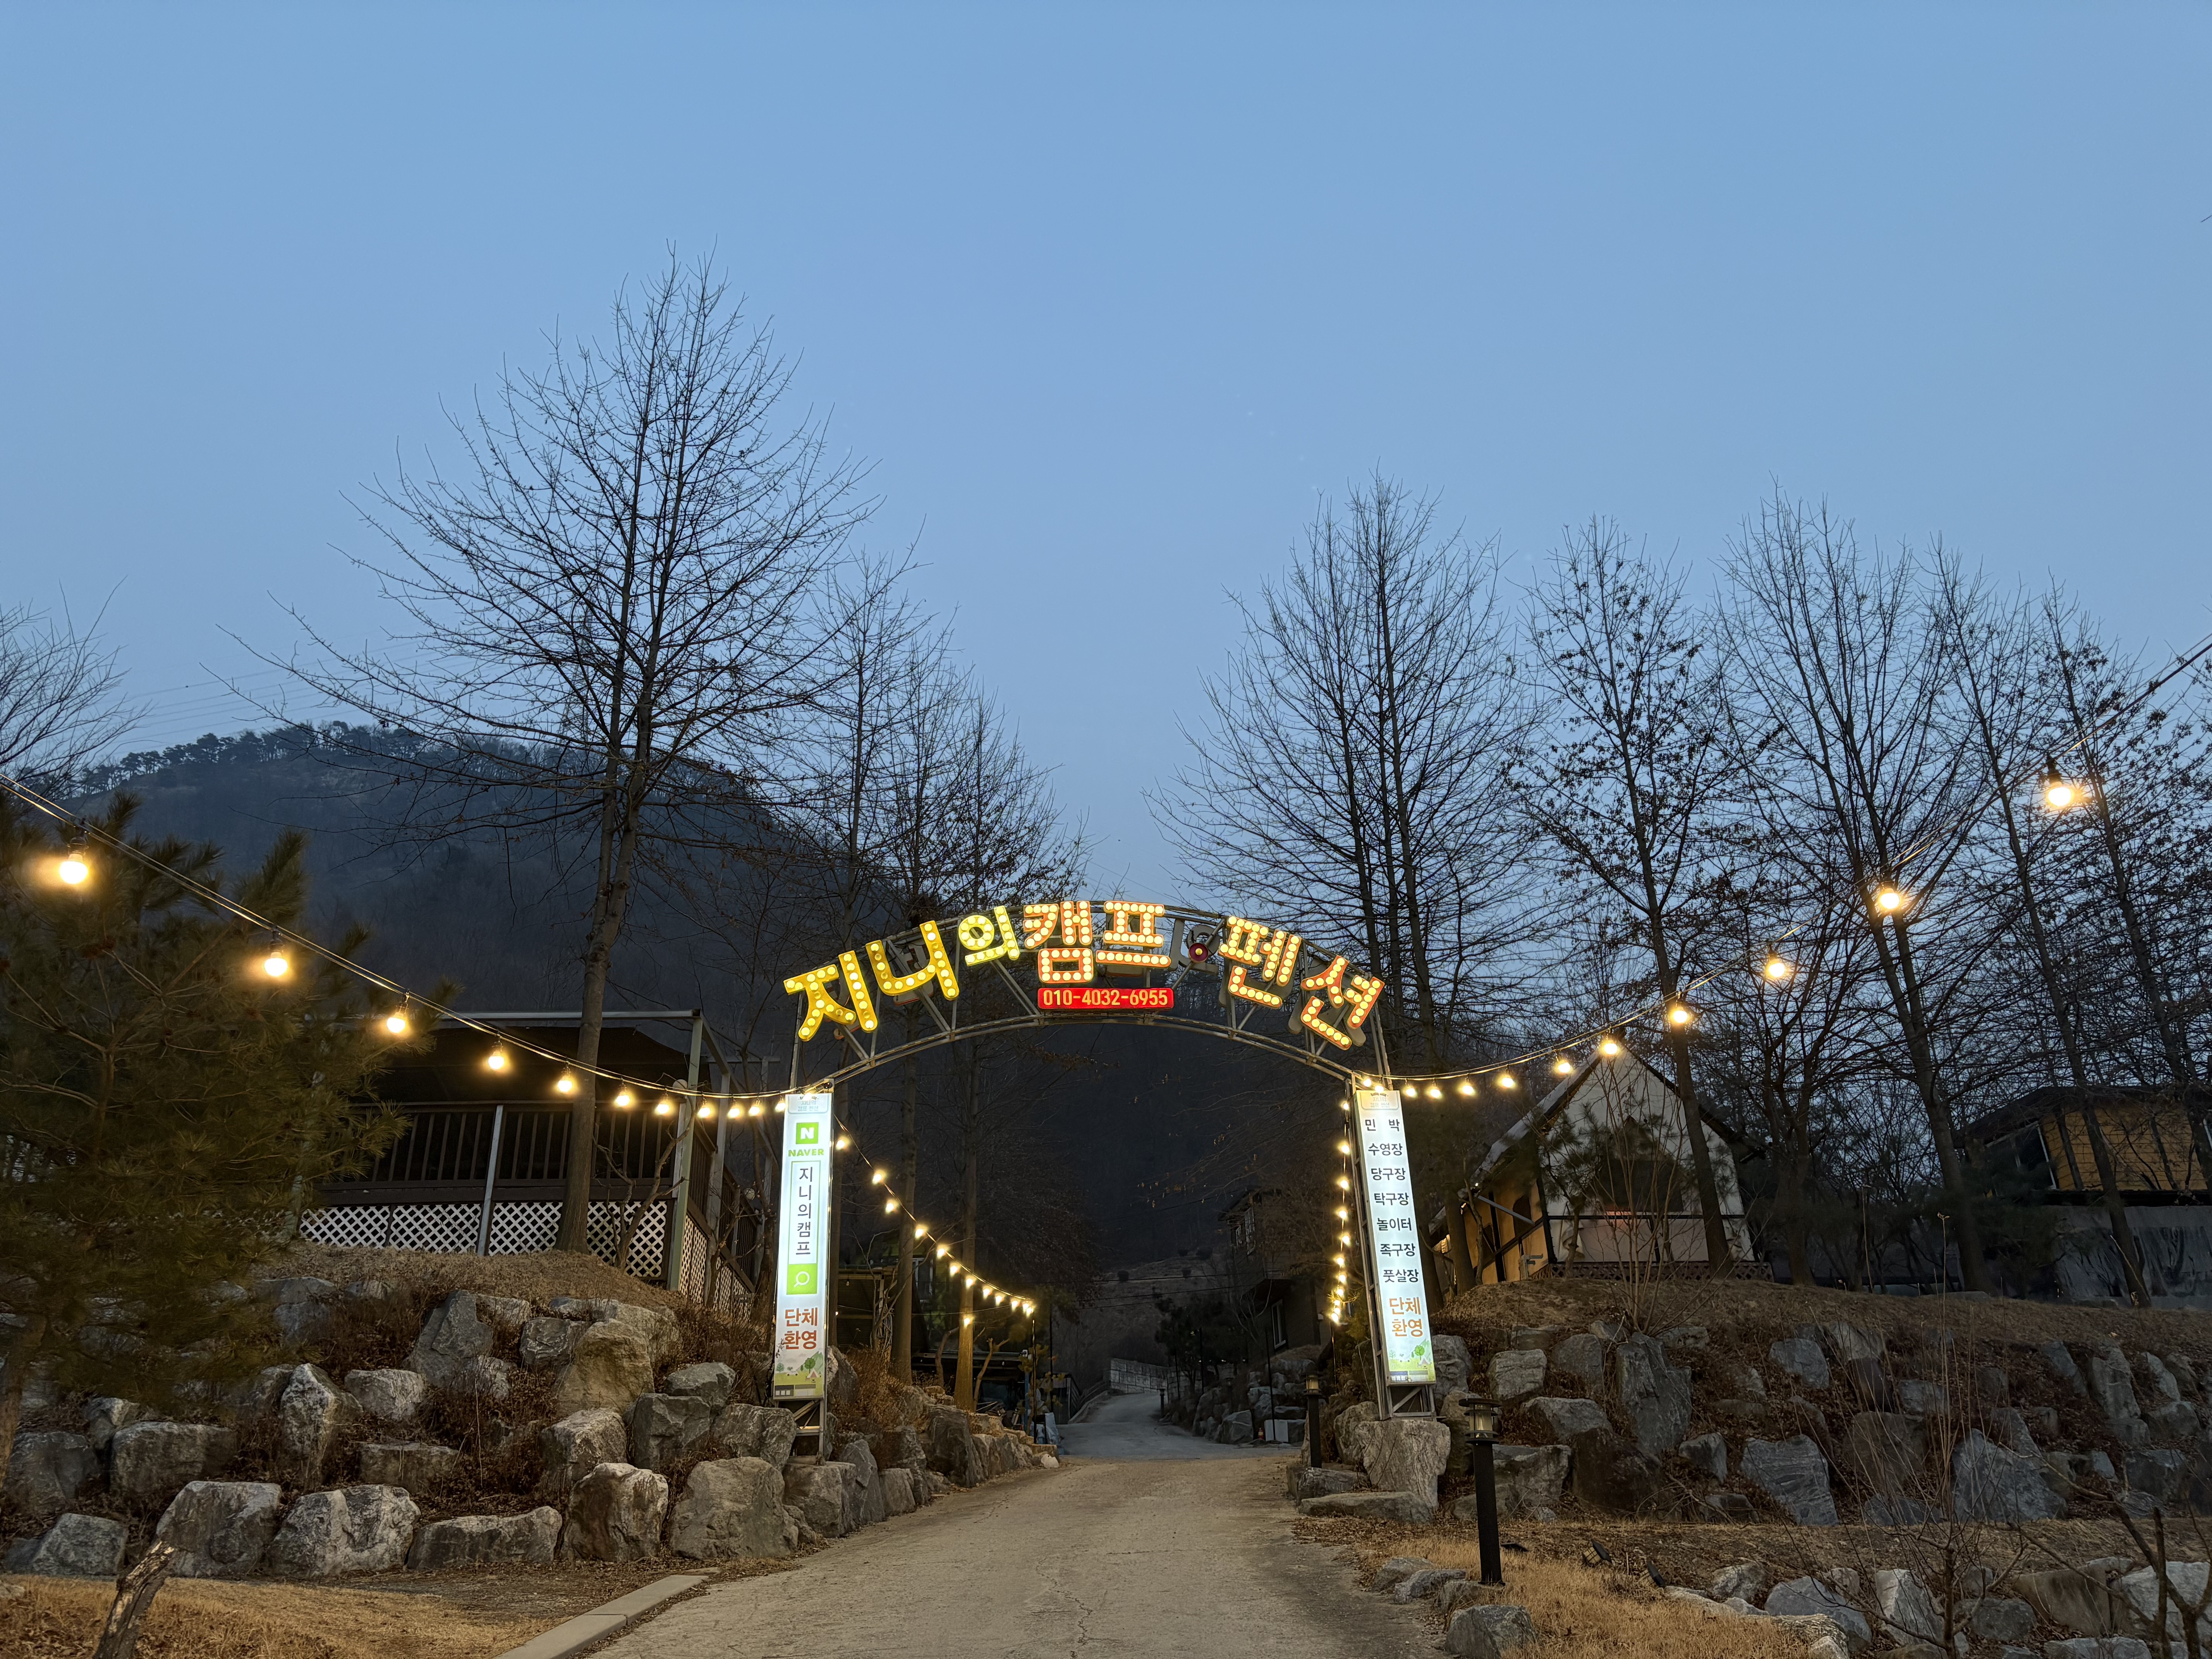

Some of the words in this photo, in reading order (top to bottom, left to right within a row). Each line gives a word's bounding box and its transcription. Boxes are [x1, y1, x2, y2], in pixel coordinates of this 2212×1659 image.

[784, 905, 1020, 1041] 지니의
[1023, 900, 1171, 984] 캠프
[1218, 915, 1385, 1050] 펜션
[1043, 989, 1168, 1006] 010-4032-6955
[800, 1127, 814, 1140] N
[788, 1148, 824, 1157] NAVER
[1368, 1143, 1403, 1156] 수영장
[1371, 1168, 1406, 1181] 당구장
[1374, 1192, 1409, 1206] 탁구장
[795, 1166, 813, 1255] 지니의캠프
[1377, 1218, 1412, 1231] 놀이터
[1380, 1243, 1416, 1257] 족구장
[1383, 1269, 1419, 1283] 풋살장
[1389, 1297, 1421, 1315] 단체
[785, 1307, 818, 1327] 단체
[1392, 1319, 1423, 1337] 환영
[784, 1330, 817, 1350] 환영
